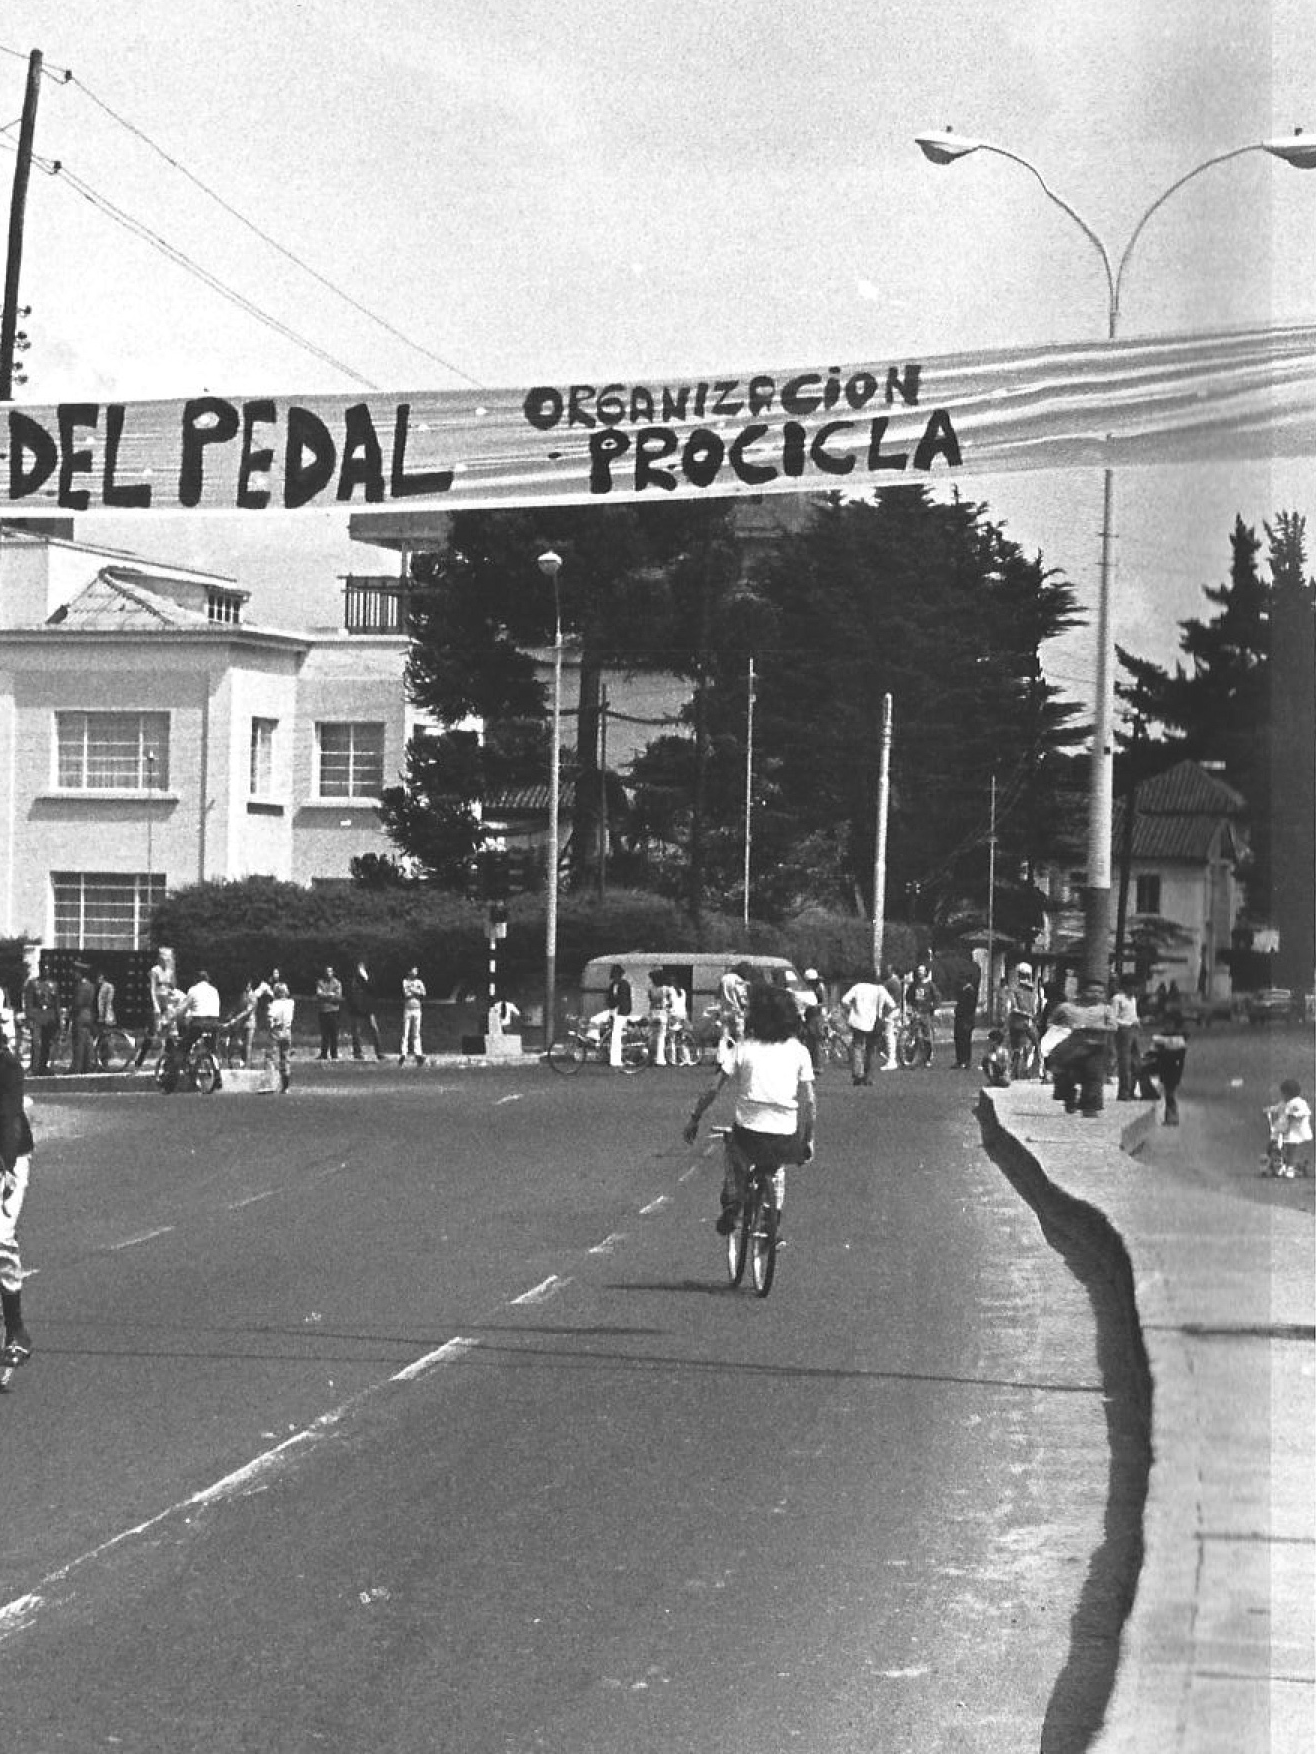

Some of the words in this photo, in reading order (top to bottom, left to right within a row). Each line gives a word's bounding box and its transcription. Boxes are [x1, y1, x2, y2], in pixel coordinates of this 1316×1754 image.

[8, 402, 152, 511] DEL
[178, 396, 454, 510] PEDAL
[588, 408, 963, 495] PROCICLA
